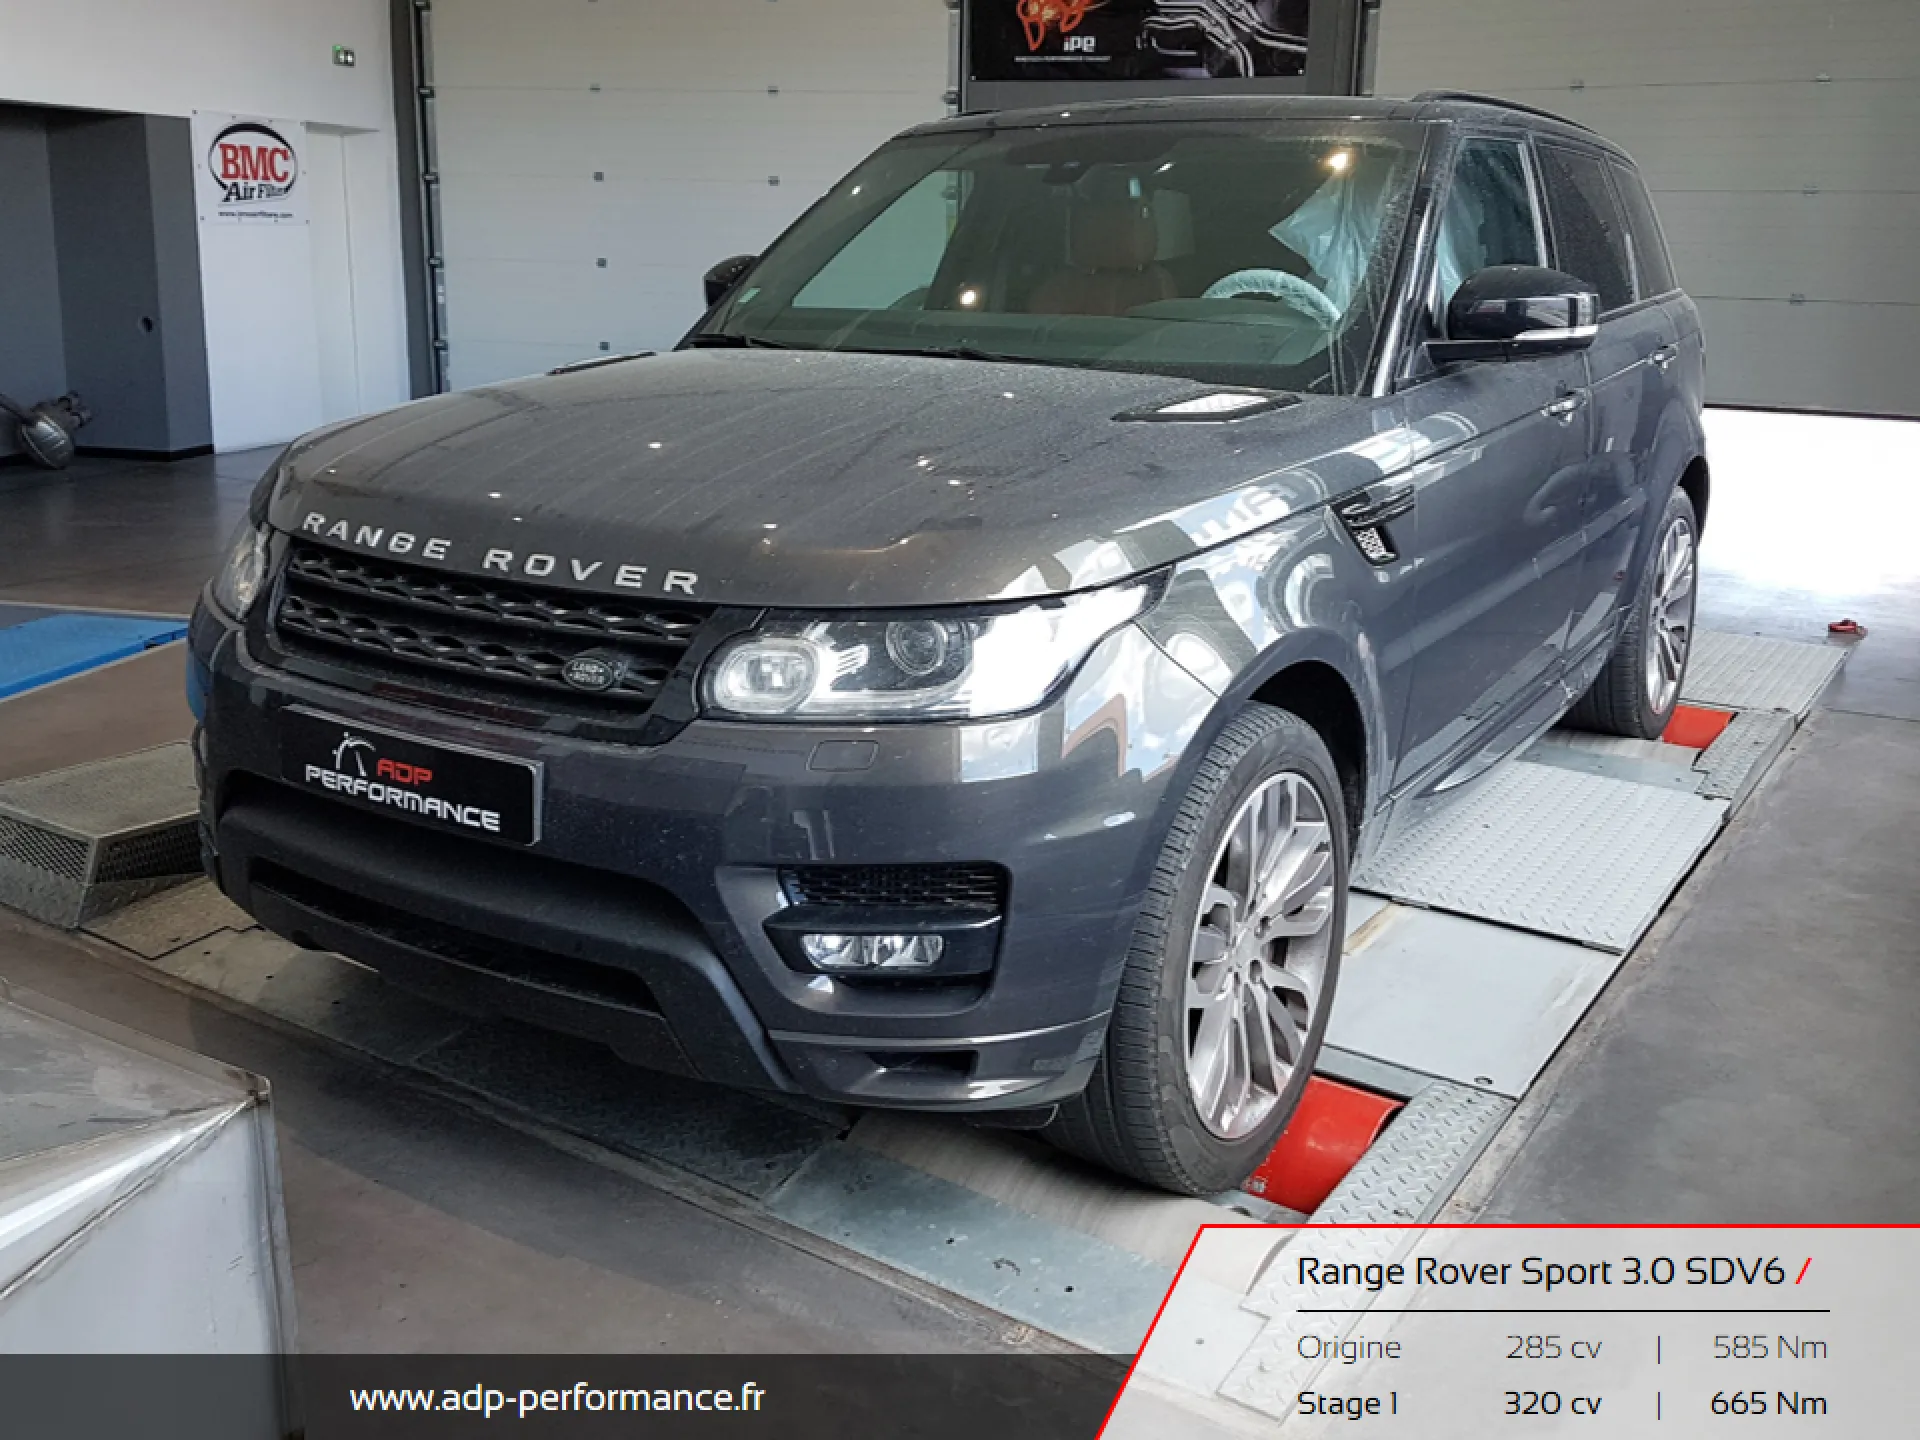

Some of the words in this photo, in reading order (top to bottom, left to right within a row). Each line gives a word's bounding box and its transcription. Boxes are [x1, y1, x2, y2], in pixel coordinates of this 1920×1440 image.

[218, 143, 290, 183] BMC
[222, 181, 256, 202] Air
[301, 511, 452, 561] RANGE
[482, 547, 699, 595] ROVER
[376, 757, 433, 787] ADP
[305, 763, 501, 833] PERFORMANCE
